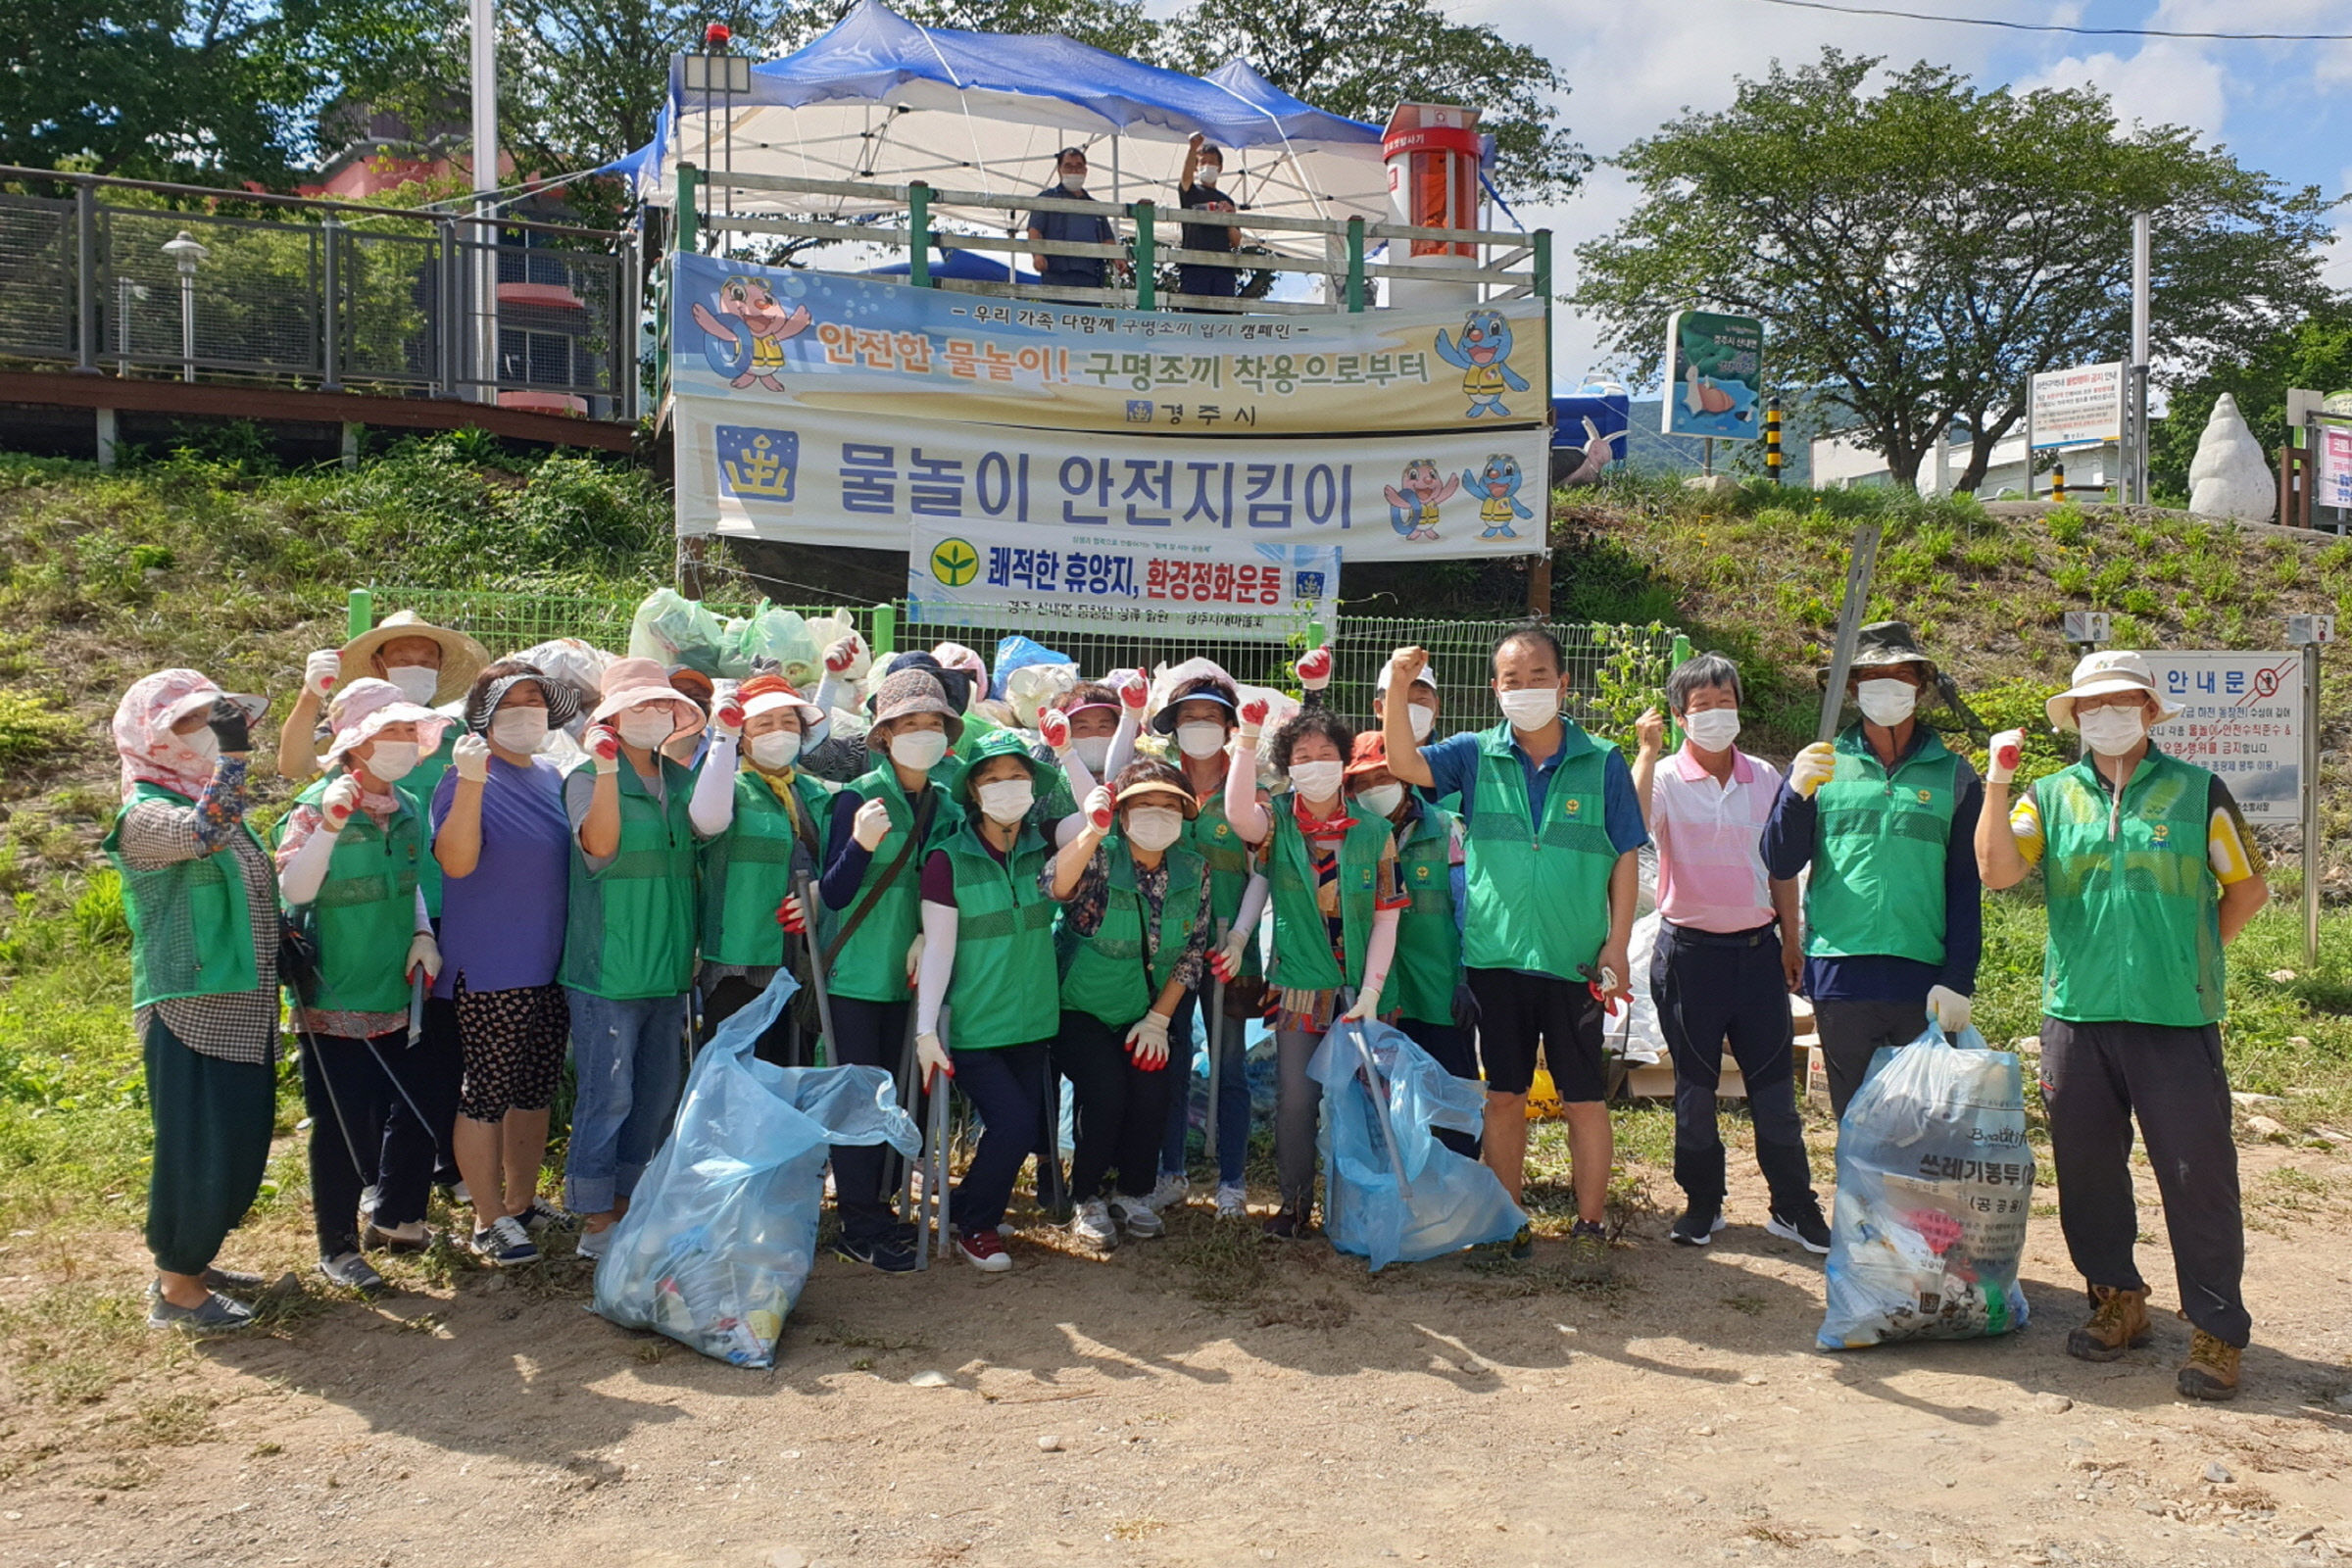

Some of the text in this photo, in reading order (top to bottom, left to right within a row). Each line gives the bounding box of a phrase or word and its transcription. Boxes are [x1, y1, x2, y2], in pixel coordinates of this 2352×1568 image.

[974, 306, 1009, 324] 우리
[1018, 310, 1054, 329] 가족
[1061, 315, 1115, 333] 다함께
[1200, 322, 1233, 339] 입기
[1240, 323, 1291, 340] 캠페인
[818, 323, 1429, 394] 안전한 물놀이! 구명조끼 착용으로부터
[840, 443, 1352, 528] 물놀이 안전지킴이
[987, 546, 1281, 606] 쾌적한 휴양지, 환경정화운동
[2198, 707, 2215, 718] 하천
[2188, 724, 2217, 737] 물놀이
[2187, 742, 2217, 755] 행위를
